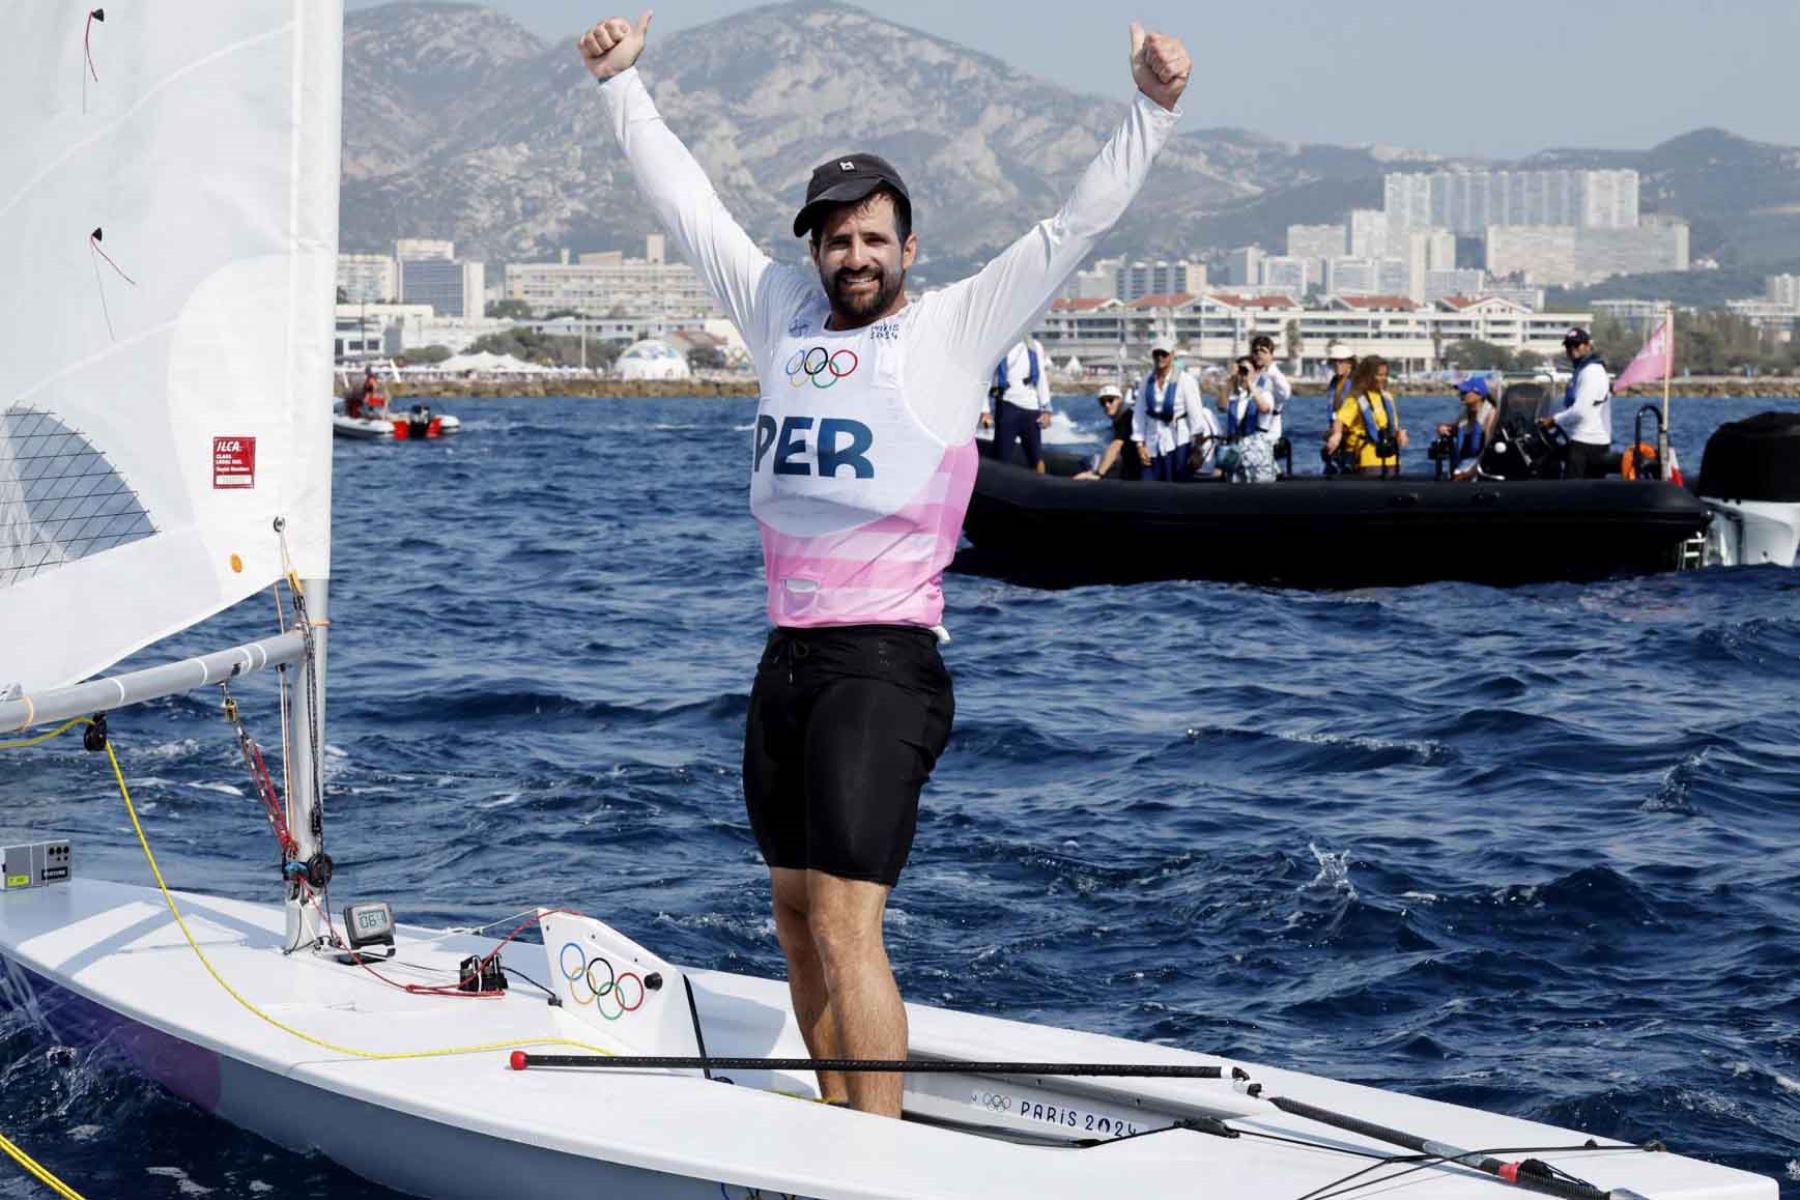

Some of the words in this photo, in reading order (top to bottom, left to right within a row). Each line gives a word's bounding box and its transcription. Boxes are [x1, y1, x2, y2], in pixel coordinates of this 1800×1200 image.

[216, 440, 240, 452] ILCA
[754, 414, 874, 479] PER
[1085, 1114, 1137, 1138] 2024
